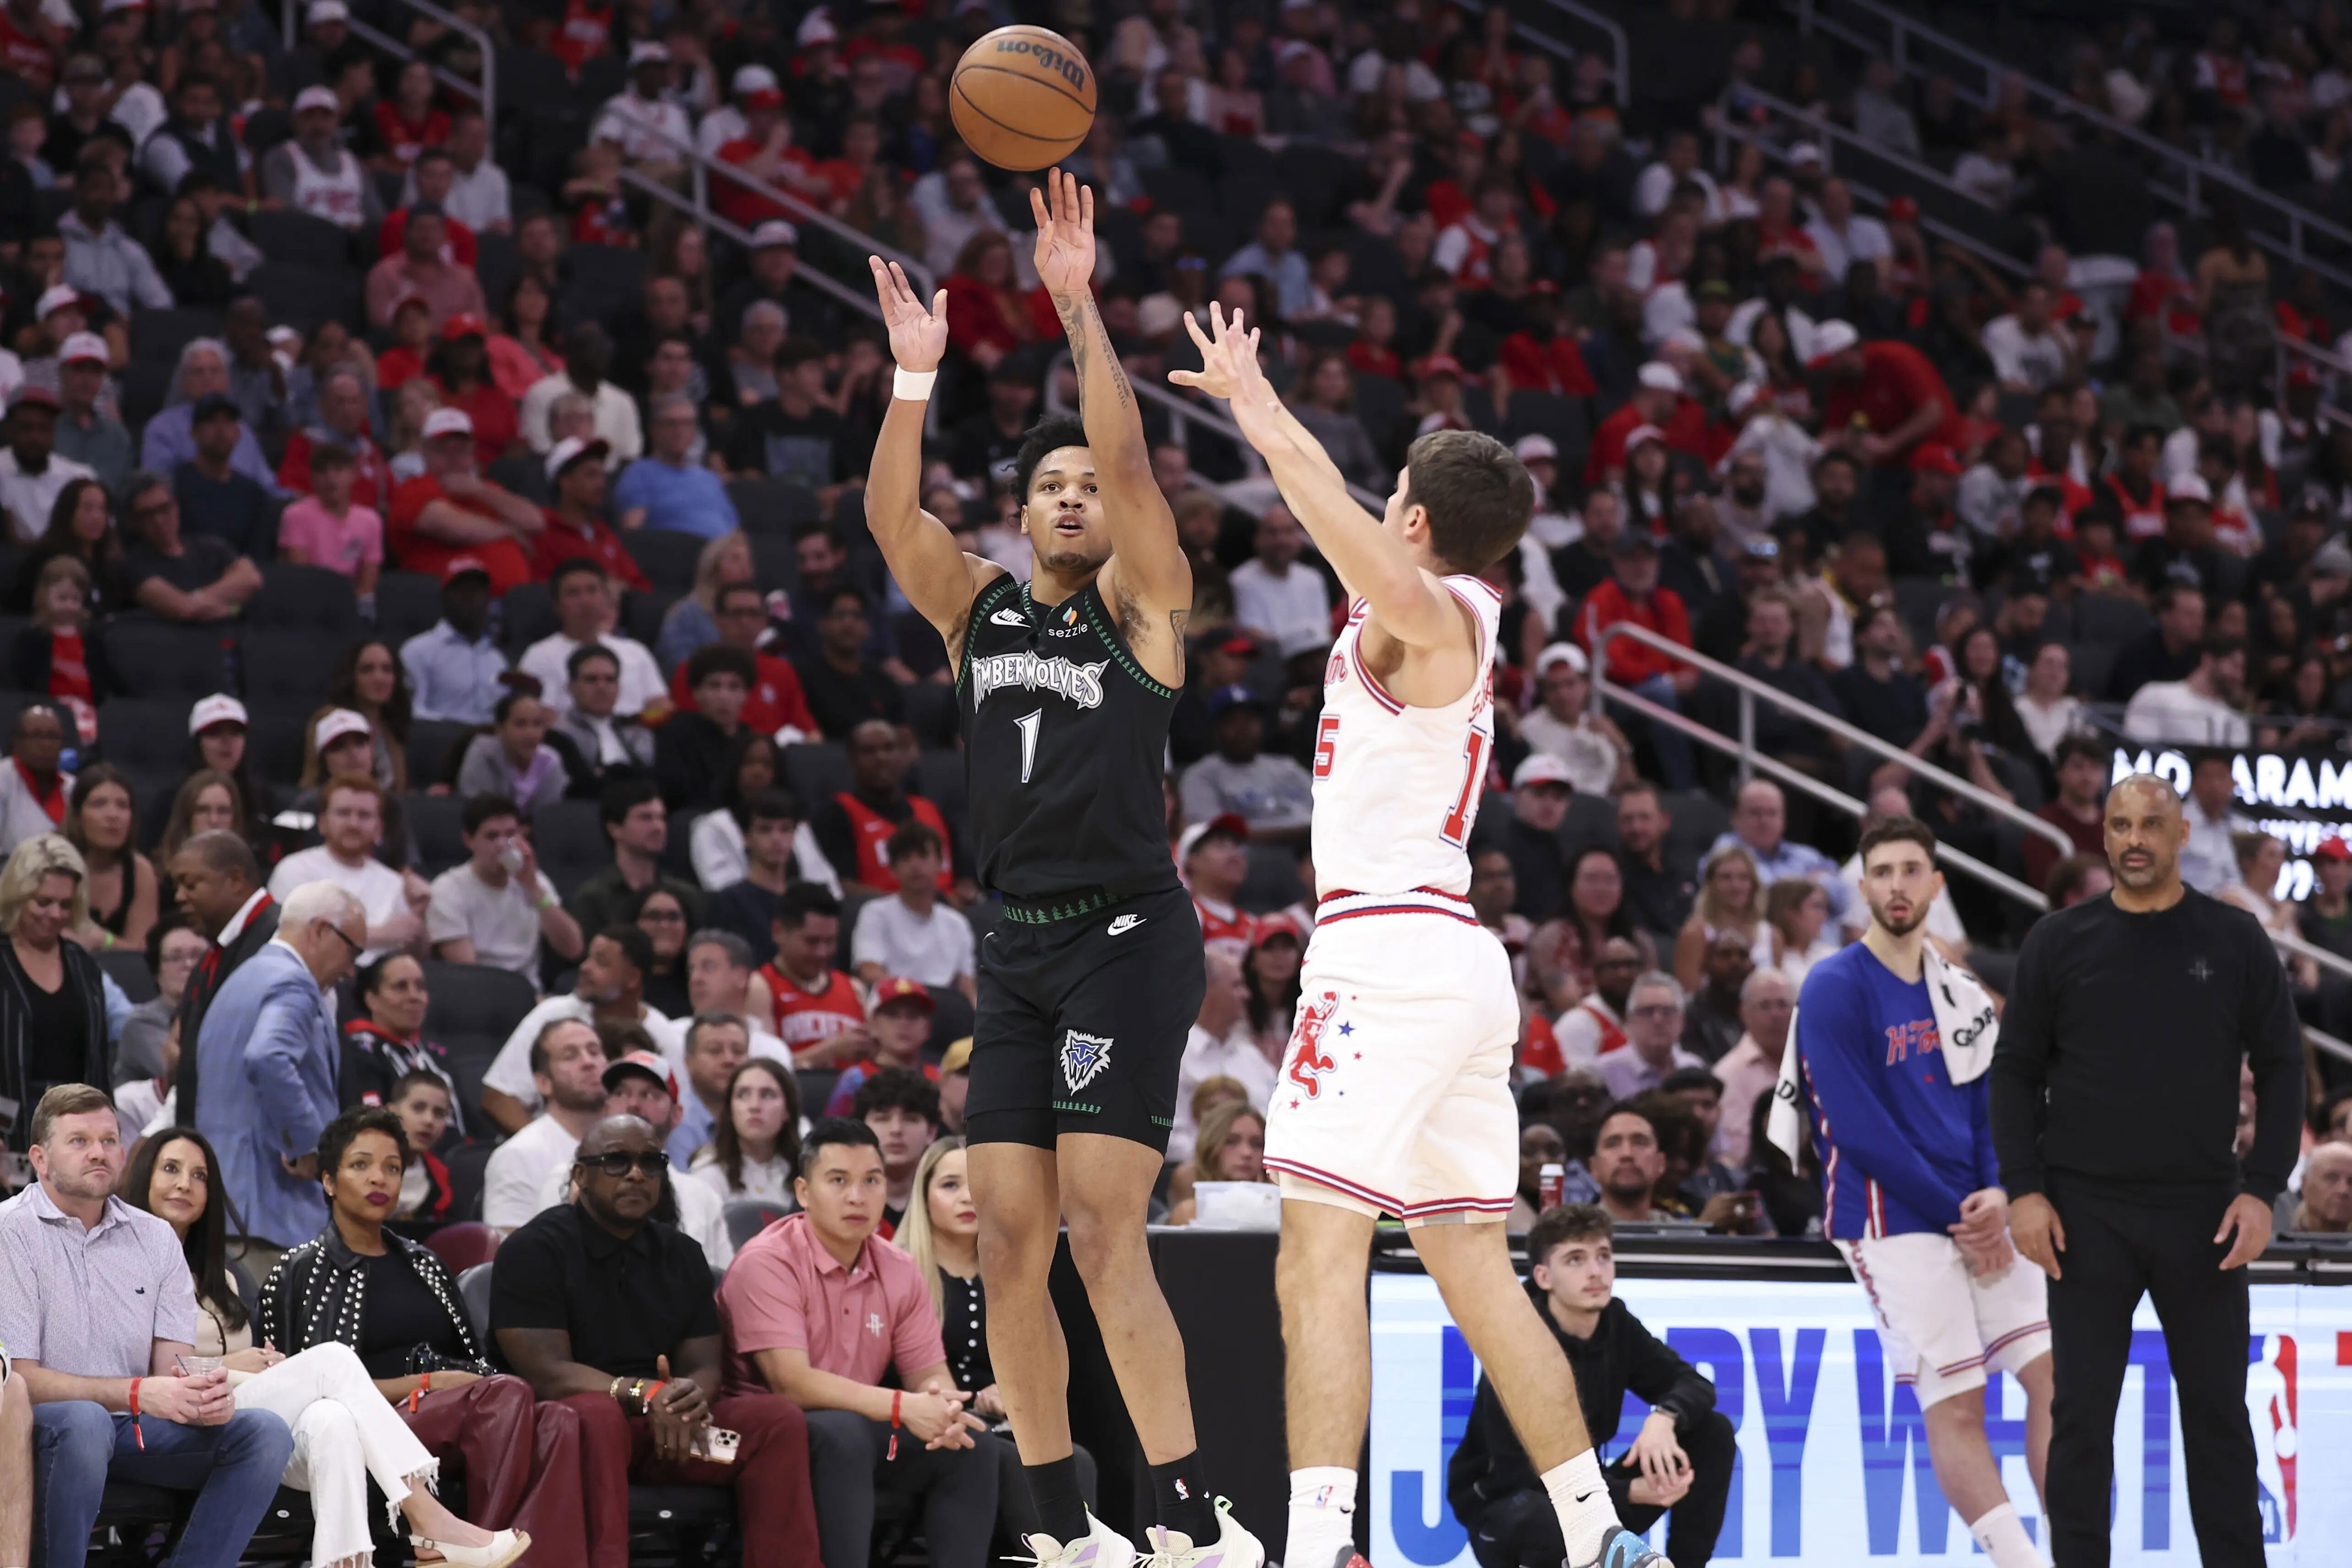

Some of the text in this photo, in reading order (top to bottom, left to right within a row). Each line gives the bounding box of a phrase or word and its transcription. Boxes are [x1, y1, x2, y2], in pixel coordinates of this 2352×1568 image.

[996, 39, 1085, 93] Wilson
[1048, 622, 1088, 638] sezzle
[1013, 707, 1042, 783] 1
